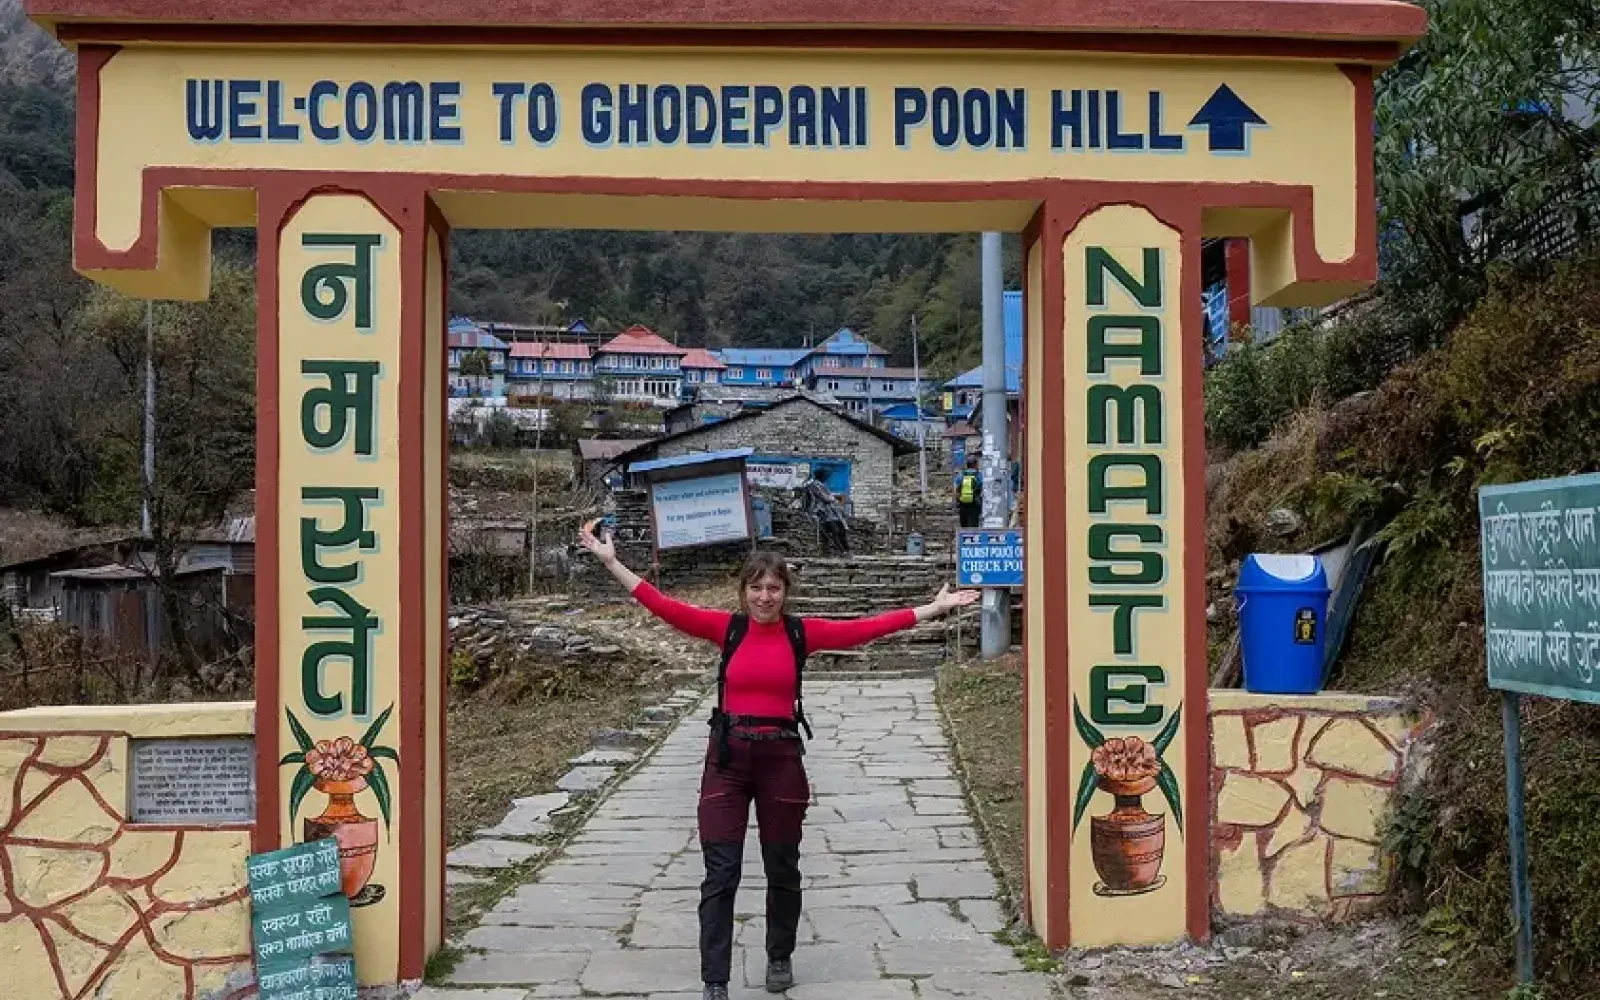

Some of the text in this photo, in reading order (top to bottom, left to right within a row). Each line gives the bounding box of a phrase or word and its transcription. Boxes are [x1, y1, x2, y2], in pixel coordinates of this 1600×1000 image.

[492, 82, 557, 146] TO
[581, 84, 867, 148] GHODEPANI
[894, 87, 1026, 150] POON
[1051, 89, 1184, 153] HILL
[1085, 246, 1168, 727] NAMASTE
[961, 547, 988, 558] TOURIST
[990, 546, 1013, 558] POLICE
[962, 560, 1001, 572] CHECK
